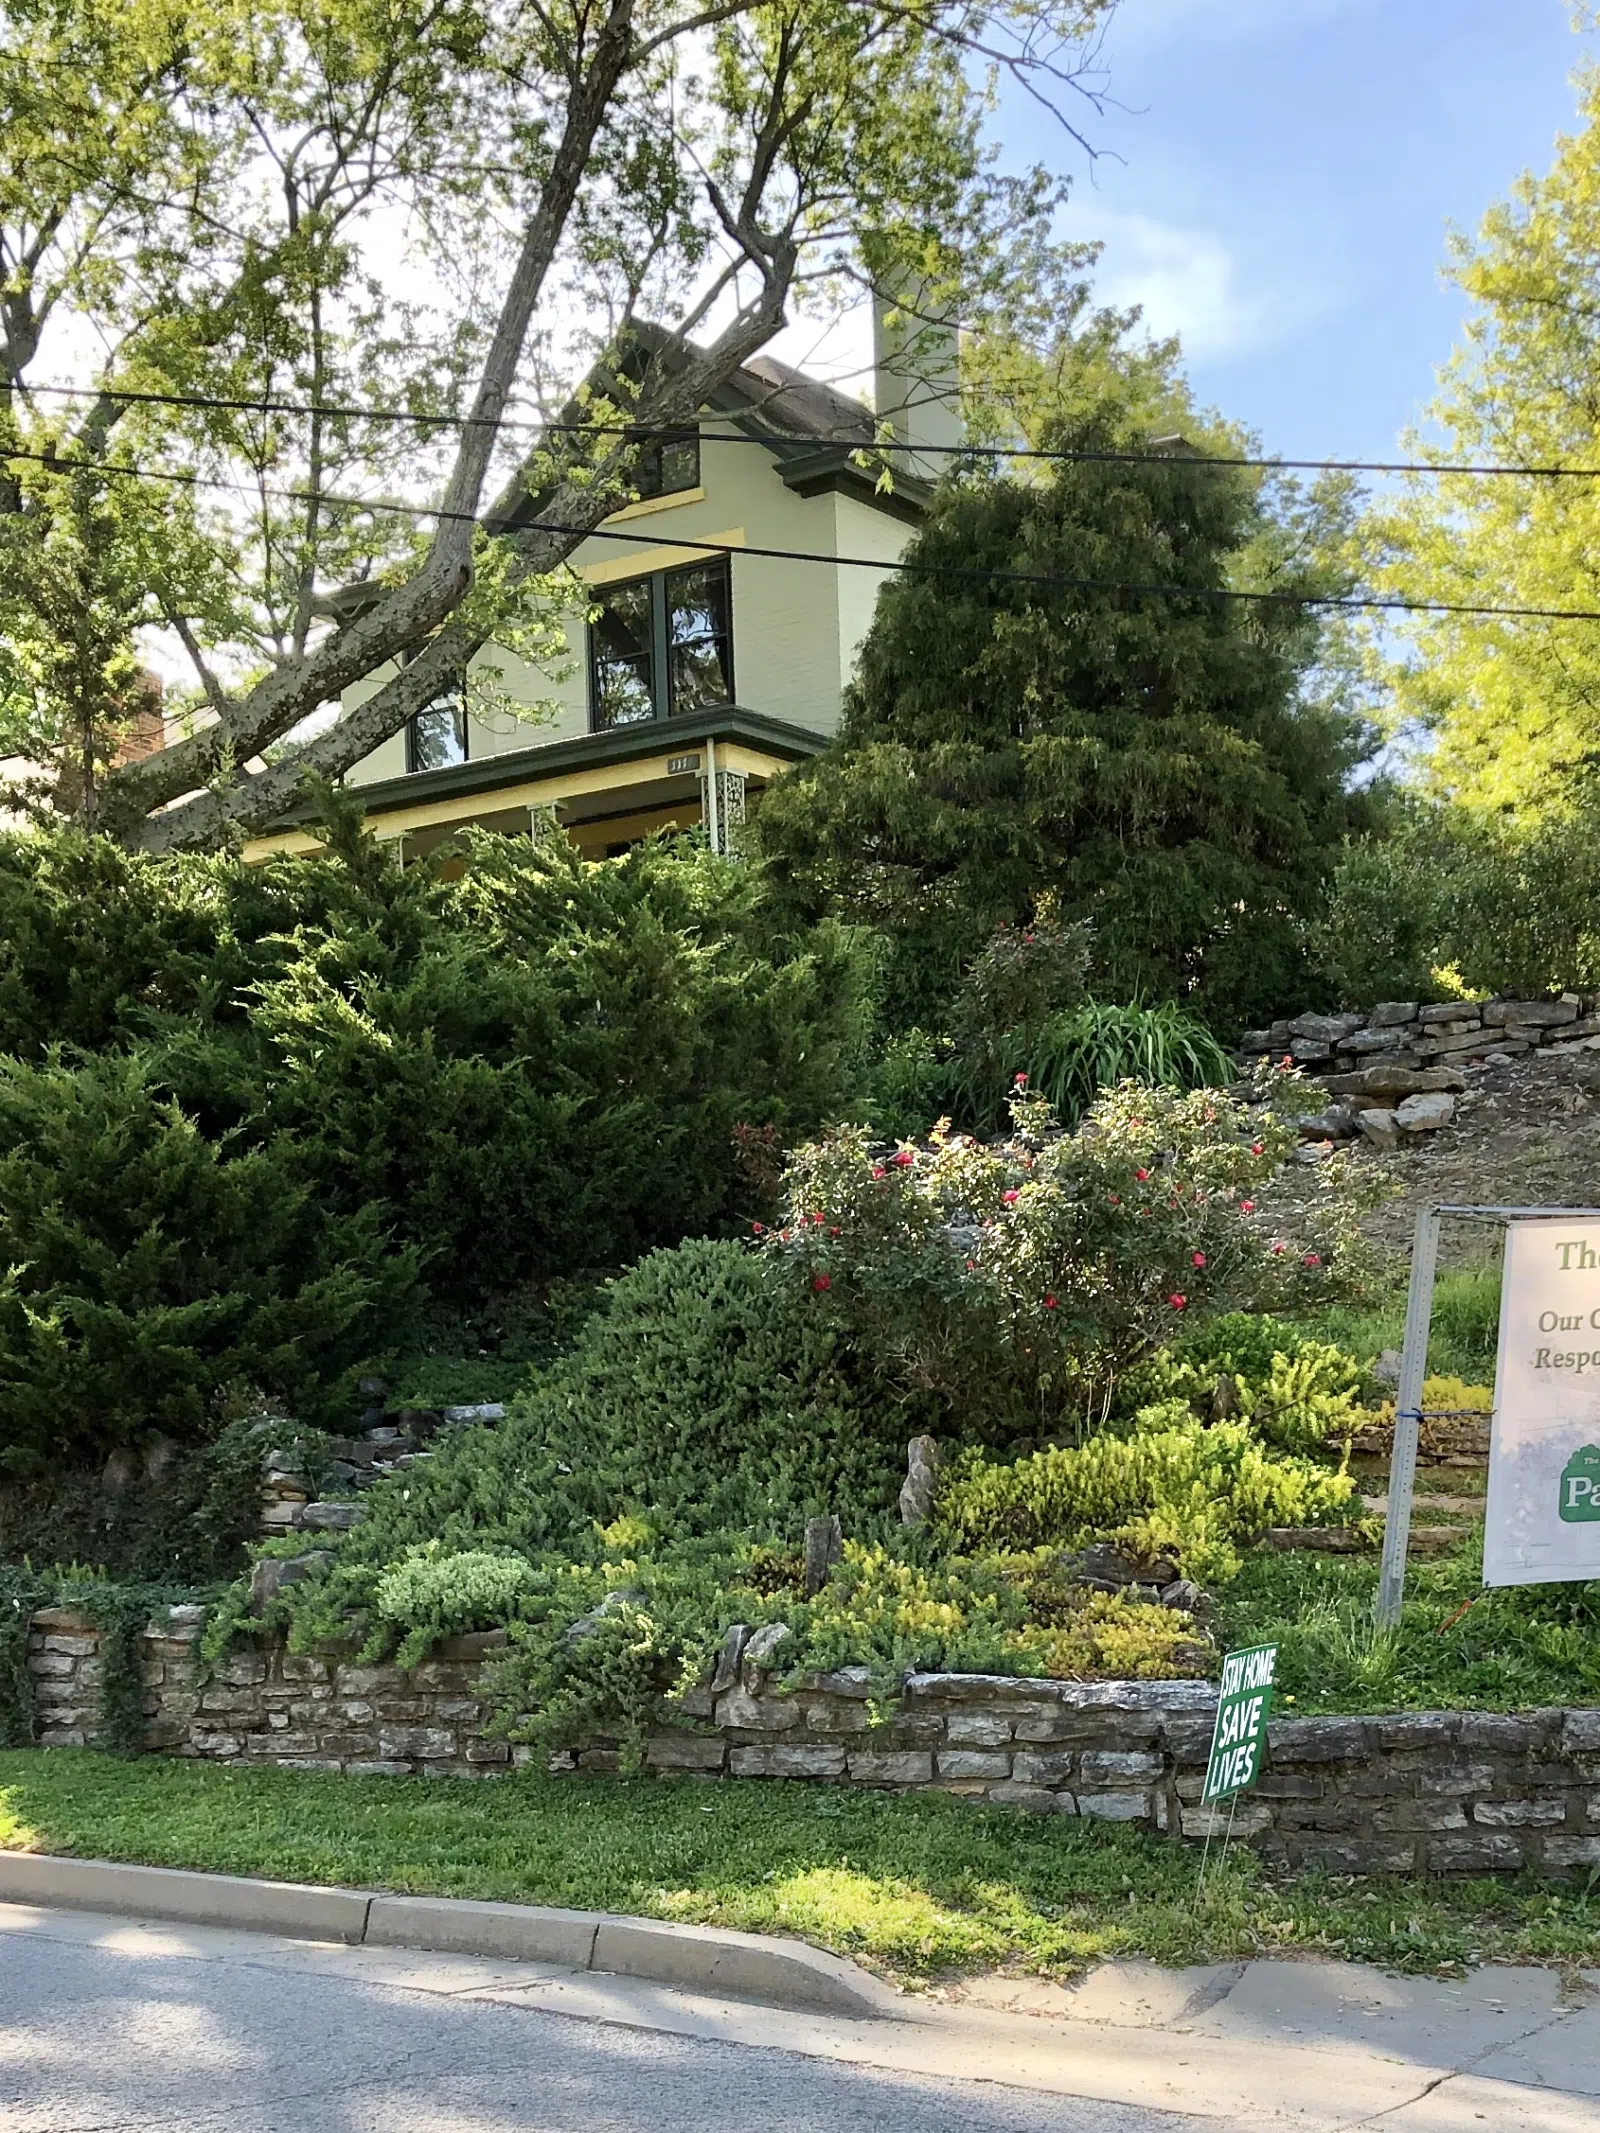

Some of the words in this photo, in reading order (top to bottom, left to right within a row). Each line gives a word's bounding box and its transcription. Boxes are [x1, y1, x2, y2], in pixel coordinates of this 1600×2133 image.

[1555, 1240, 1600, 1270] Th
[1538, 1311, 1584, 1332] Our
[1223, 1656, 1246, 1699] STAY
[1243, 1649, 1277, 1692] HOME
[1218, 1696, 1264, 1749] SAVE
[1208, 1742, 1257, 1798] LIVES
